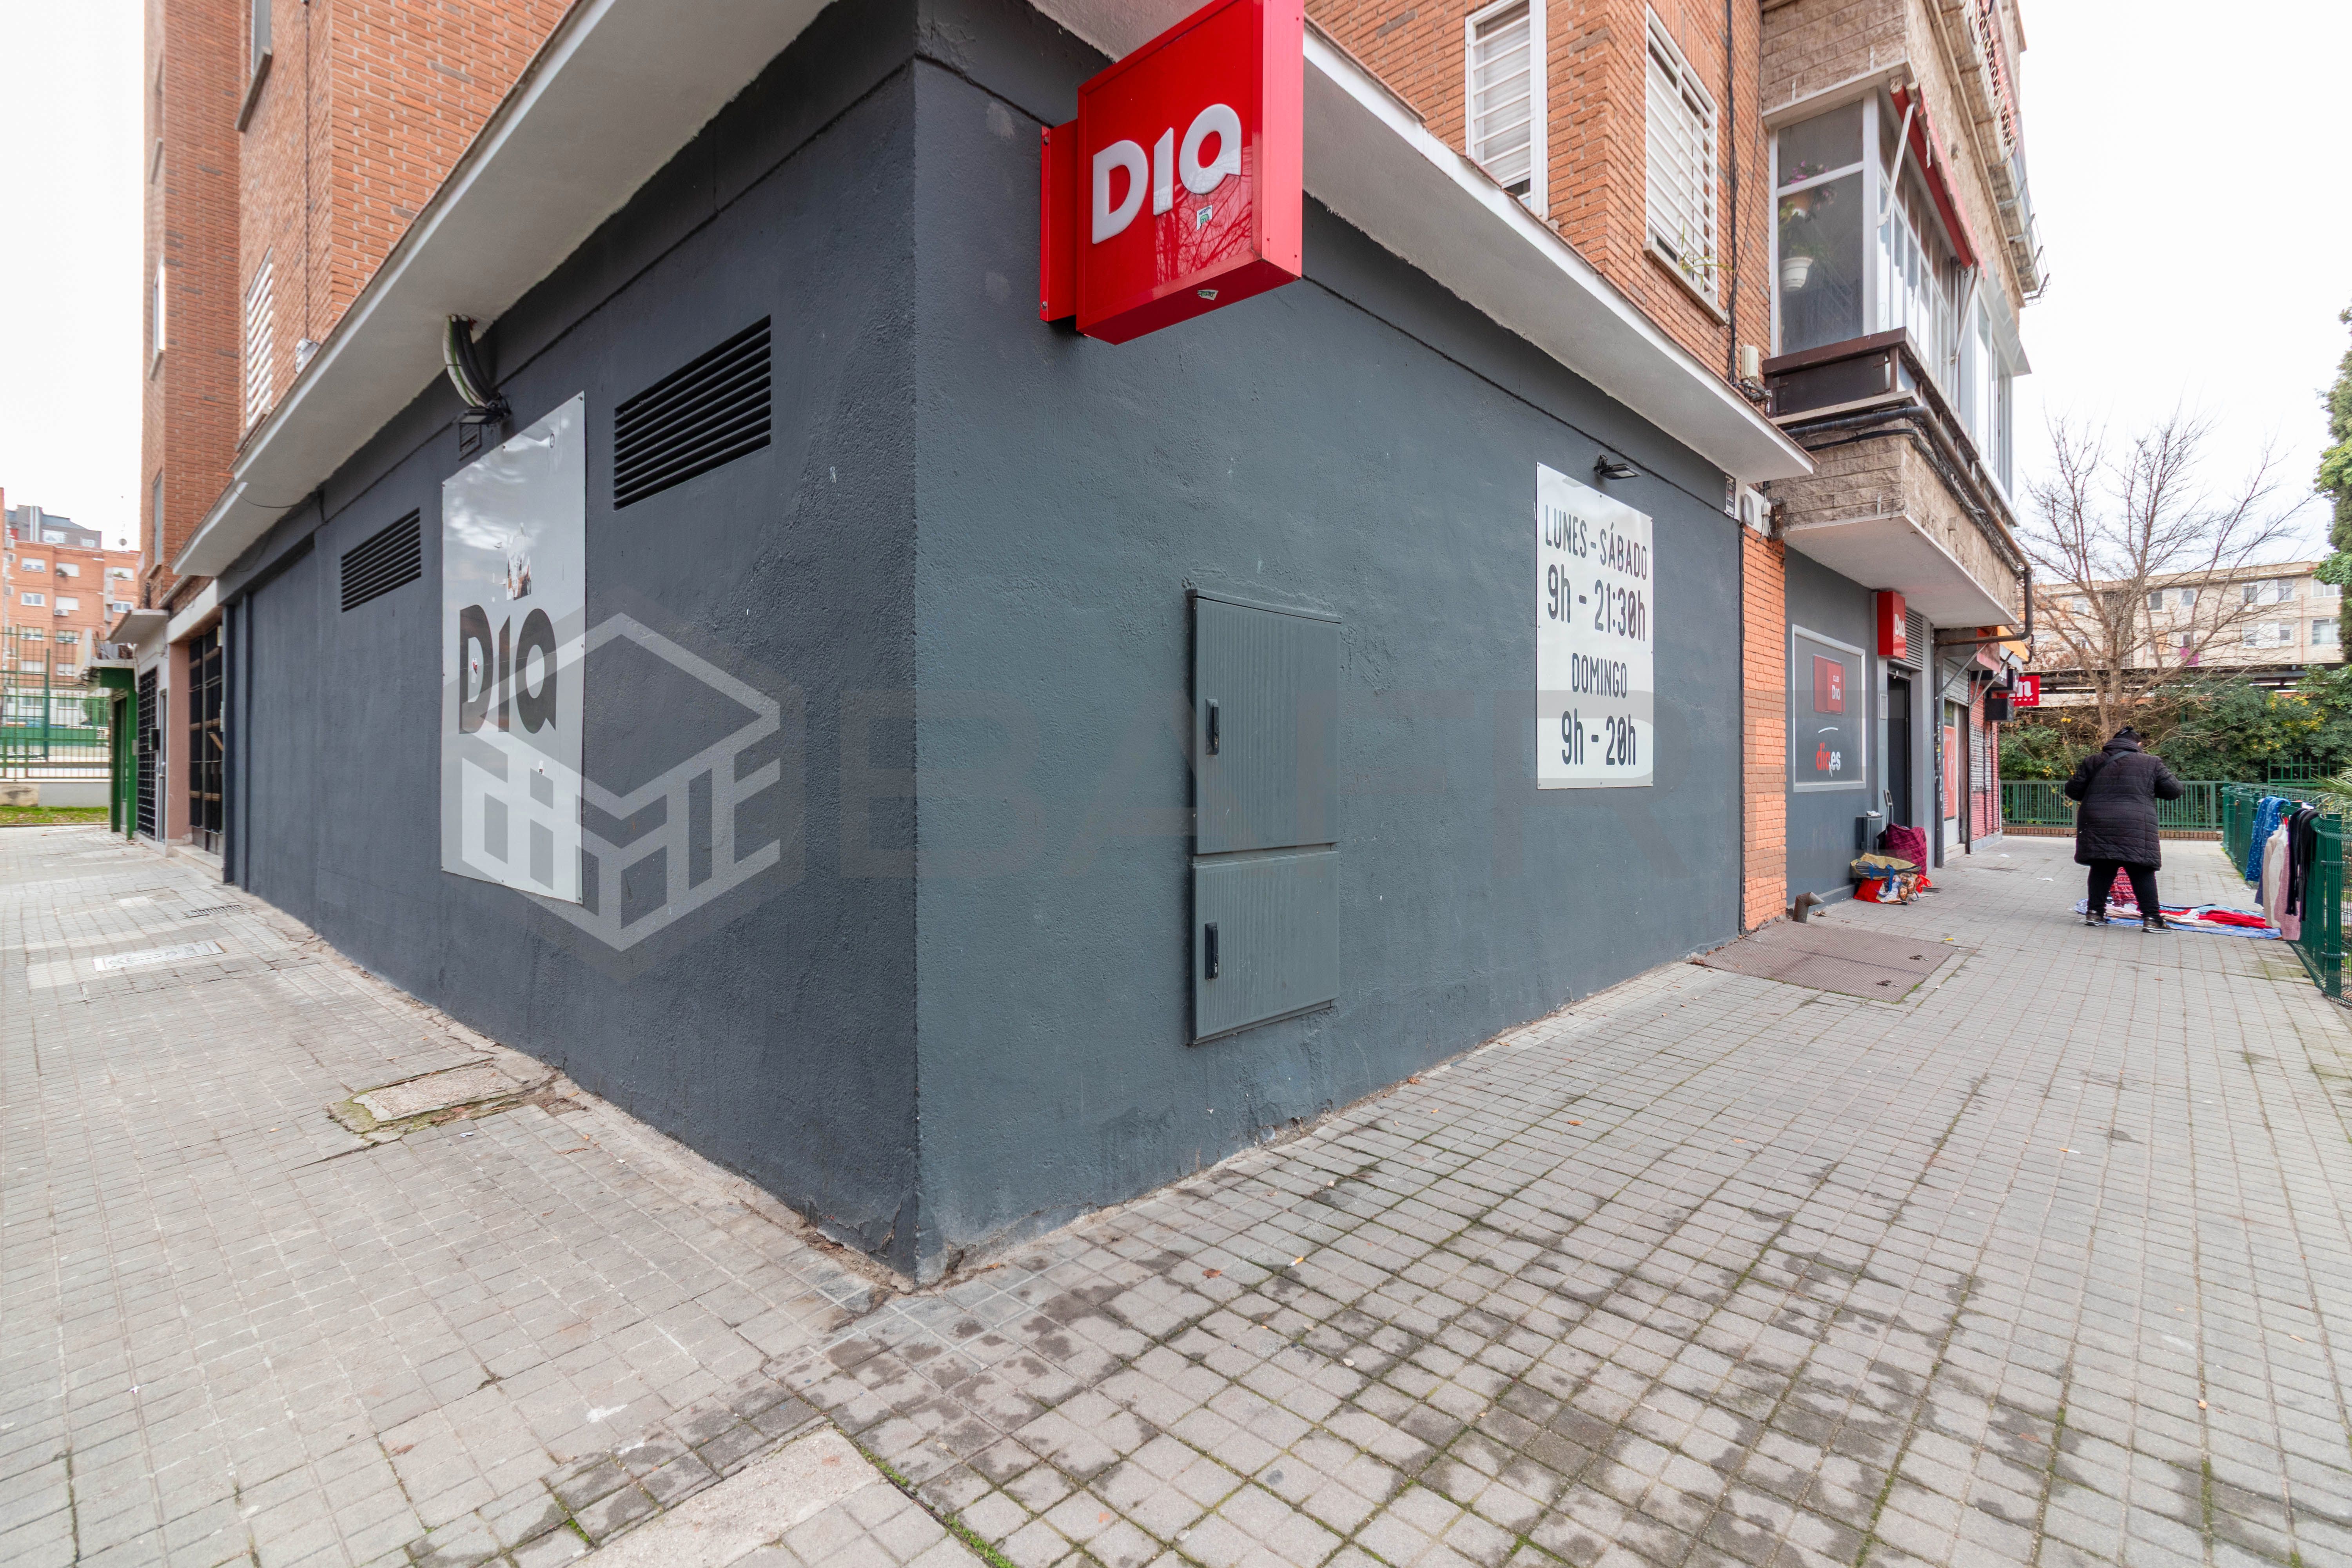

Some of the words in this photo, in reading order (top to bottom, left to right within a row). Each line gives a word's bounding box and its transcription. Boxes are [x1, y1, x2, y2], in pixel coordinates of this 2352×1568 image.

[1548, 564, 1570, 623] 9h
[1595, 579, 1645, 641] 21:30h
[1572, 653, 1627, 699] DOMINGO
[1561, 708, 1583, 766] 9h
[1606, 713, 1636, 766] 20h
